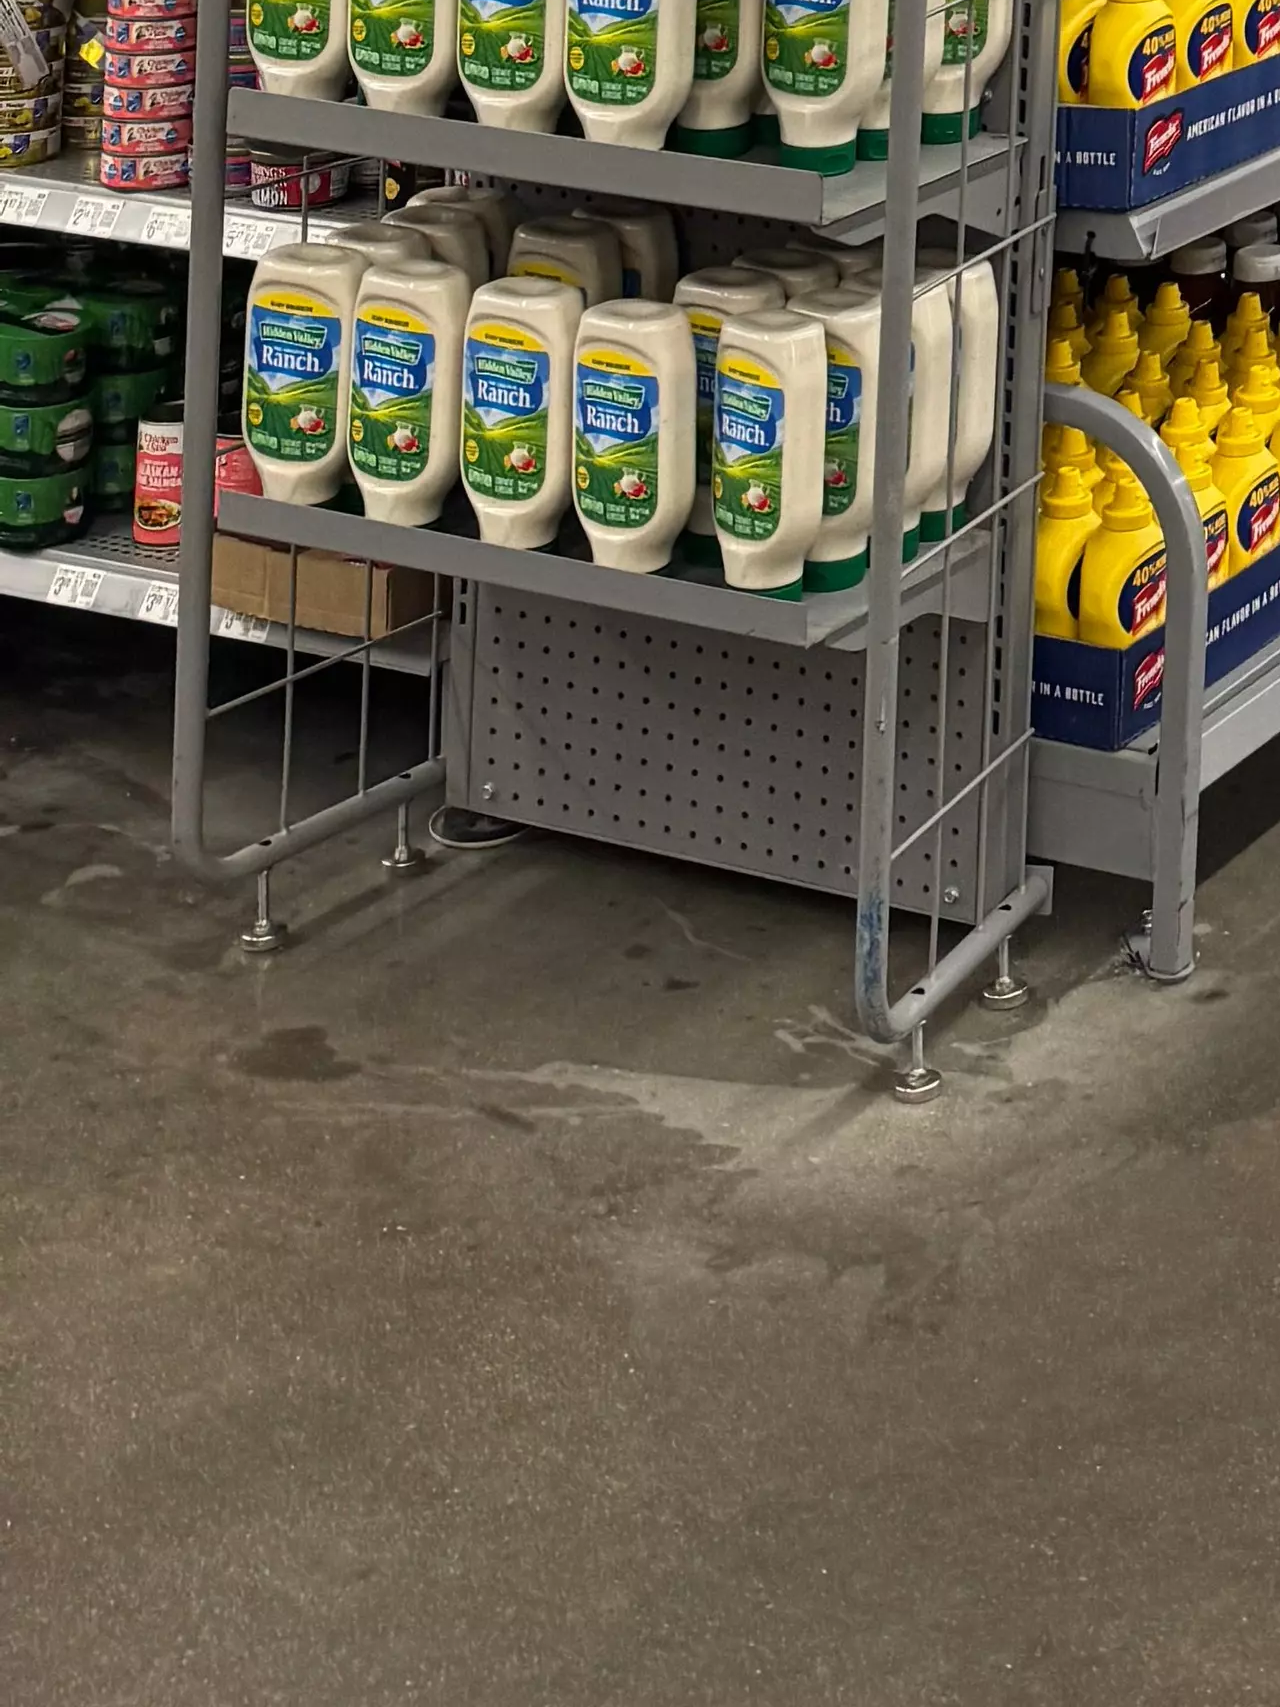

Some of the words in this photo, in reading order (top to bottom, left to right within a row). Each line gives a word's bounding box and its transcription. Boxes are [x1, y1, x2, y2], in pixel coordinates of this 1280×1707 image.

[1187, 115, 1225, 140] AMERICAN
[1077, 152, 1115, 165] BOTTLE
[1066, 686, 1103, 706] BOTTLE
